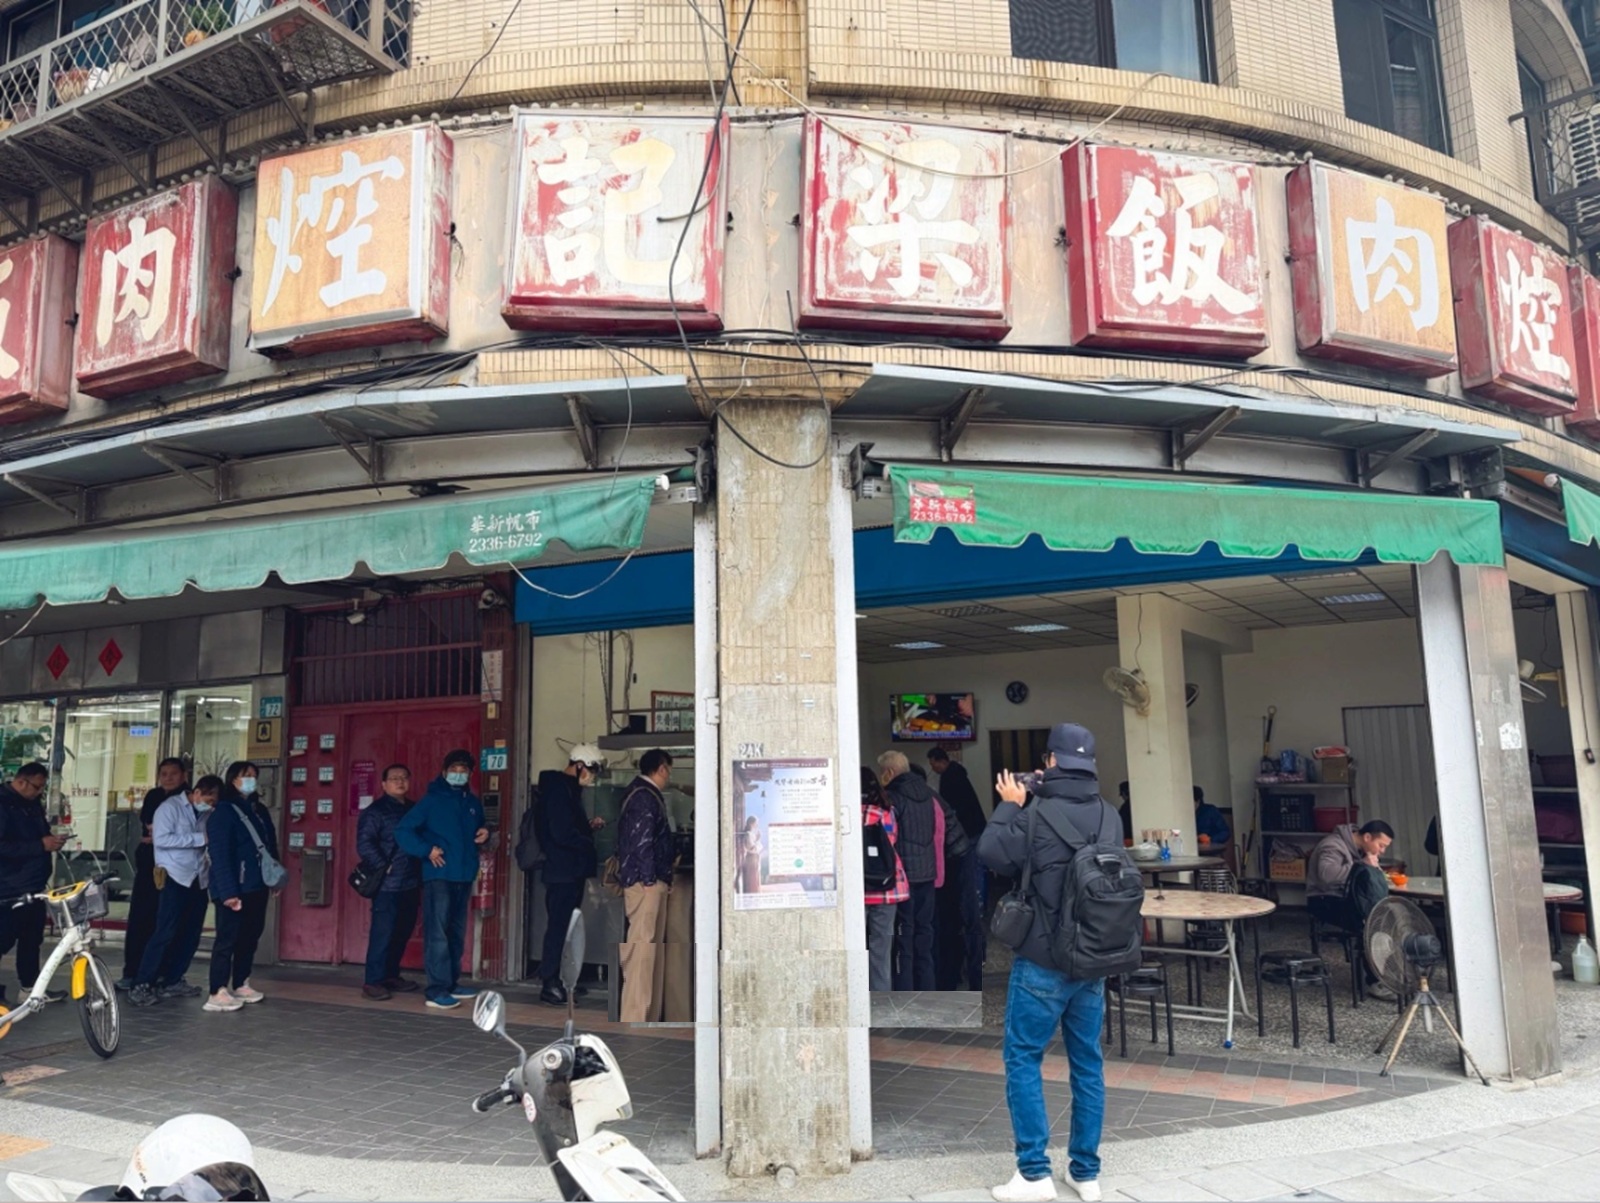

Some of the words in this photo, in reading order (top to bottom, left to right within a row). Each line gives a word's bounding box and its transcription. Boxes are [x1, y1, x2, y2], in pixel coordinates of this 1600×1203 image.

[262, 150, 404, 317] 焢
[537, 135, 693, 287] 記
[847, 138, 980, 298] 梁
[1106, 171, 1258, 315] 飯
[1344, 196, 1440, 331] 肉
[96, 215, 177, 349] 肉
[1501, 248, 1571, 380] 焢
[468, 532, 543, 553] 2336-6792
[470, 510, 542, 535] 華新帆布
[912, 511, 974, 523] 2336-6792
[268, 704, 279, 716] 72
[491, 755, 504, 768] 70
